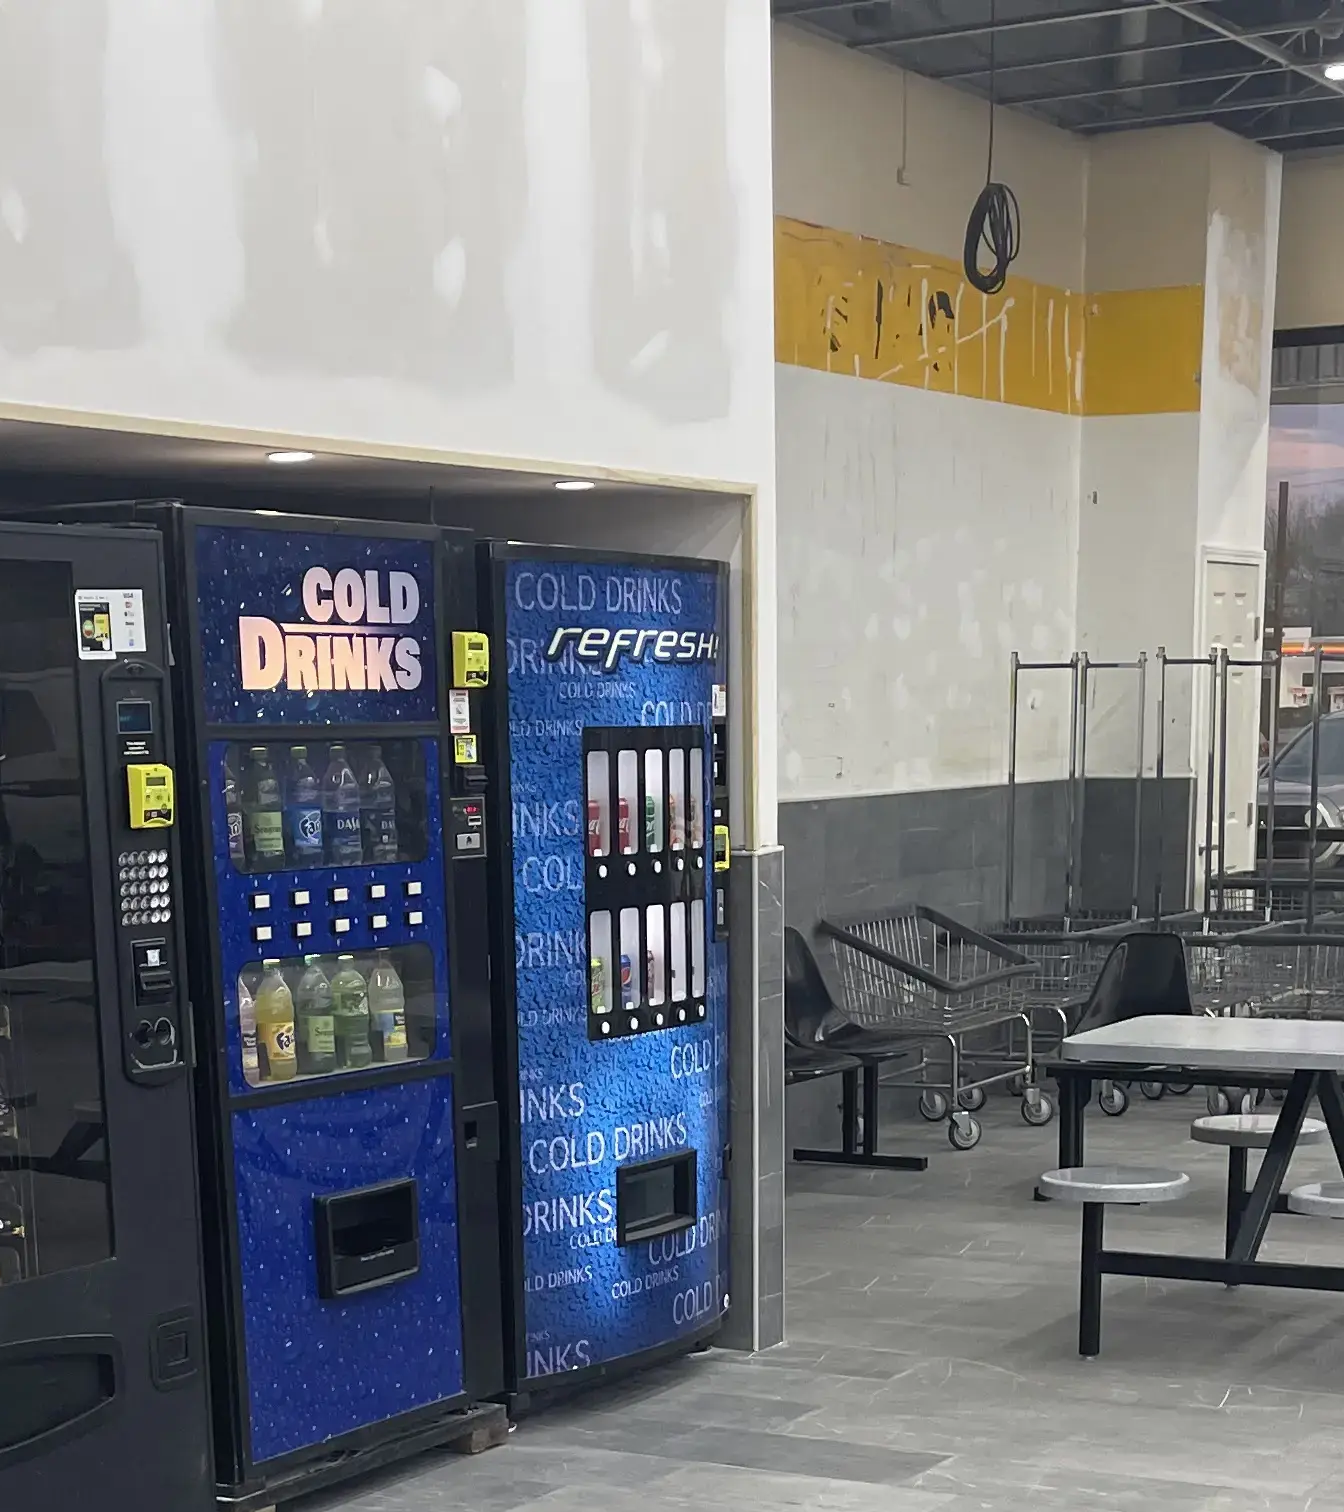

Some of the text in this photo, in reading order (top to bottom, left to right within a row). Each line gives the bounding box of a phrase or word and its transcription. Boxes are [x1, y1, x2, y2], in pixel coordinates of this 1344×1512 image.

[302, 566, 420, 624] COLD
[514, 572, 682, 615] COLD DRINKS
[238, 615, 423, 692] DRINKS
[535, 718, 584, 737] DRINKS
[528, 1130, 606, 1175] COLD
[614, 1111, 687, 1161] DRINKS
[548, 1265, 593, 1289] DRINKS
[611, 1264, 680, 1299] COLD DRINKS
[672, 1280, 712, 1325] COLD
